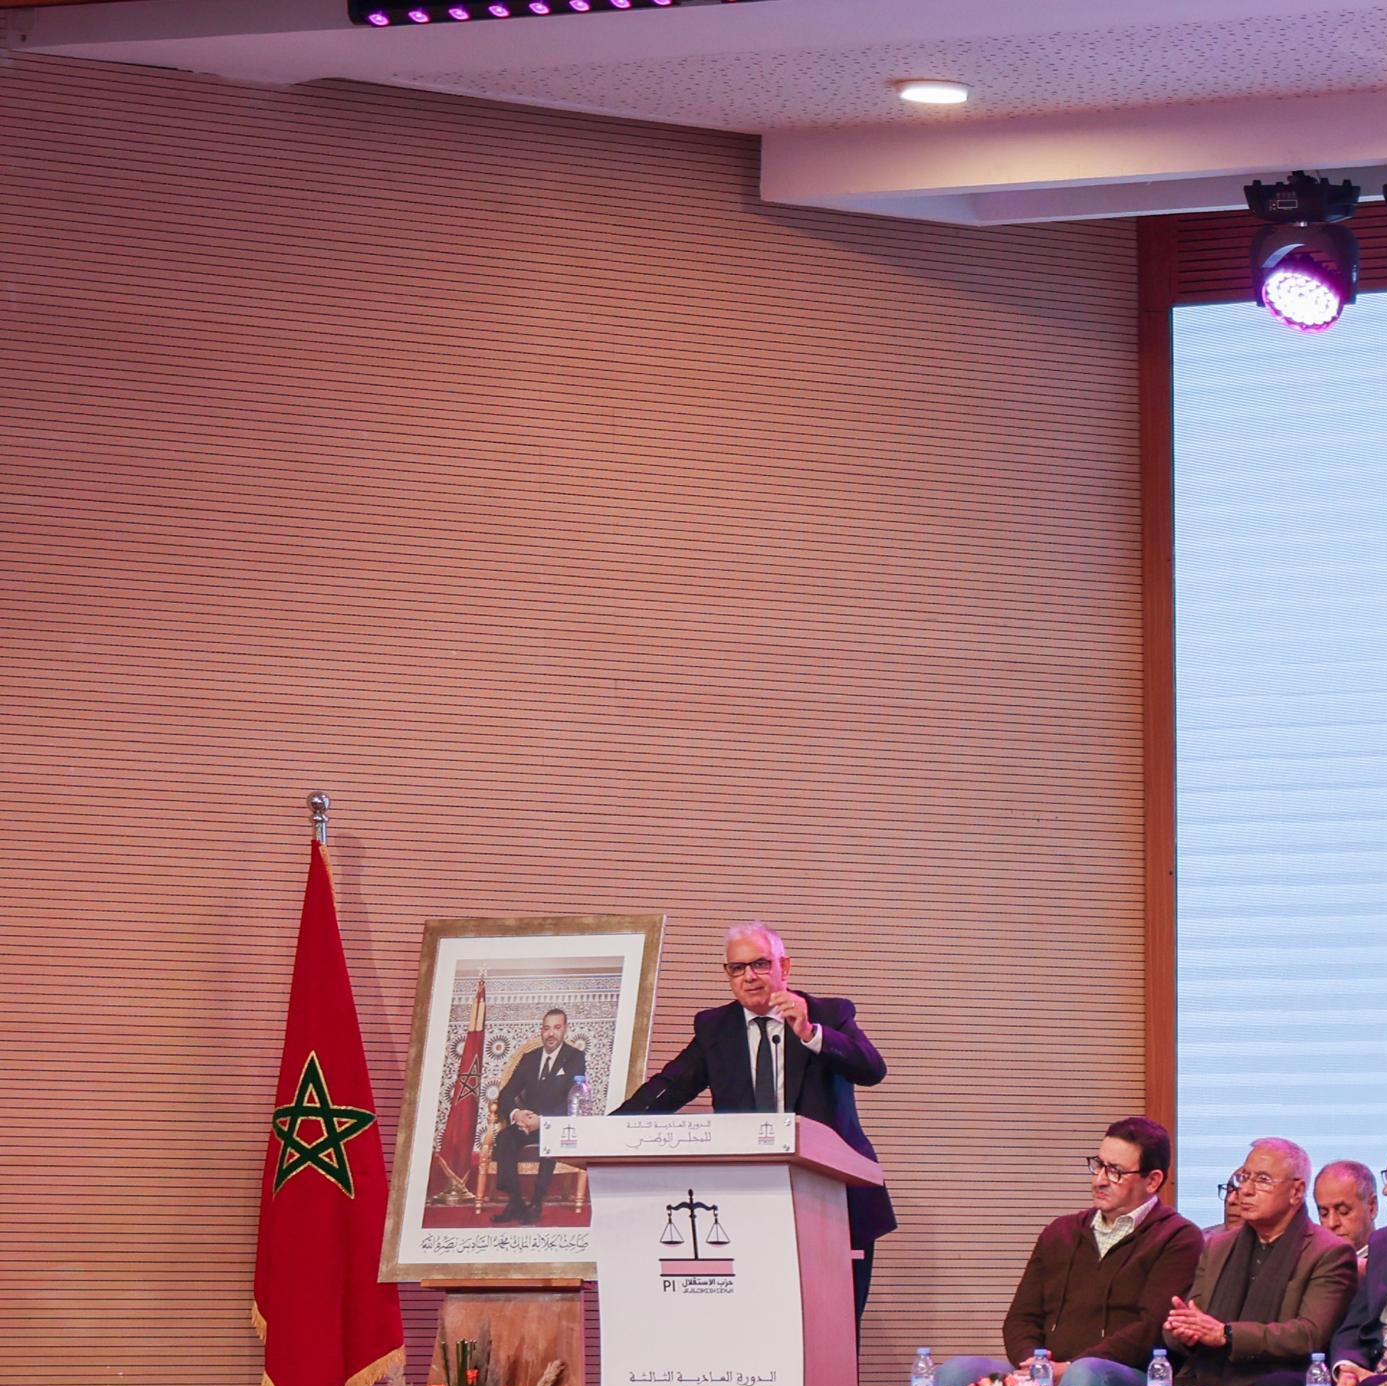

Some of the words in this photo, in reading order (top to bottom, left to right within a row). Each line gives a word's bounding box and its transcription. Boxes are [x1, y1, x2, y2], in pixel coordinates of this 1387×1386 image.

[663, 1279, 676, 1292] PI
[629, 1371, 674, 1382] الثالثة
[677, 1371, 733, 1384] العادية
[736, 1371, 776, 1386] الدورة
